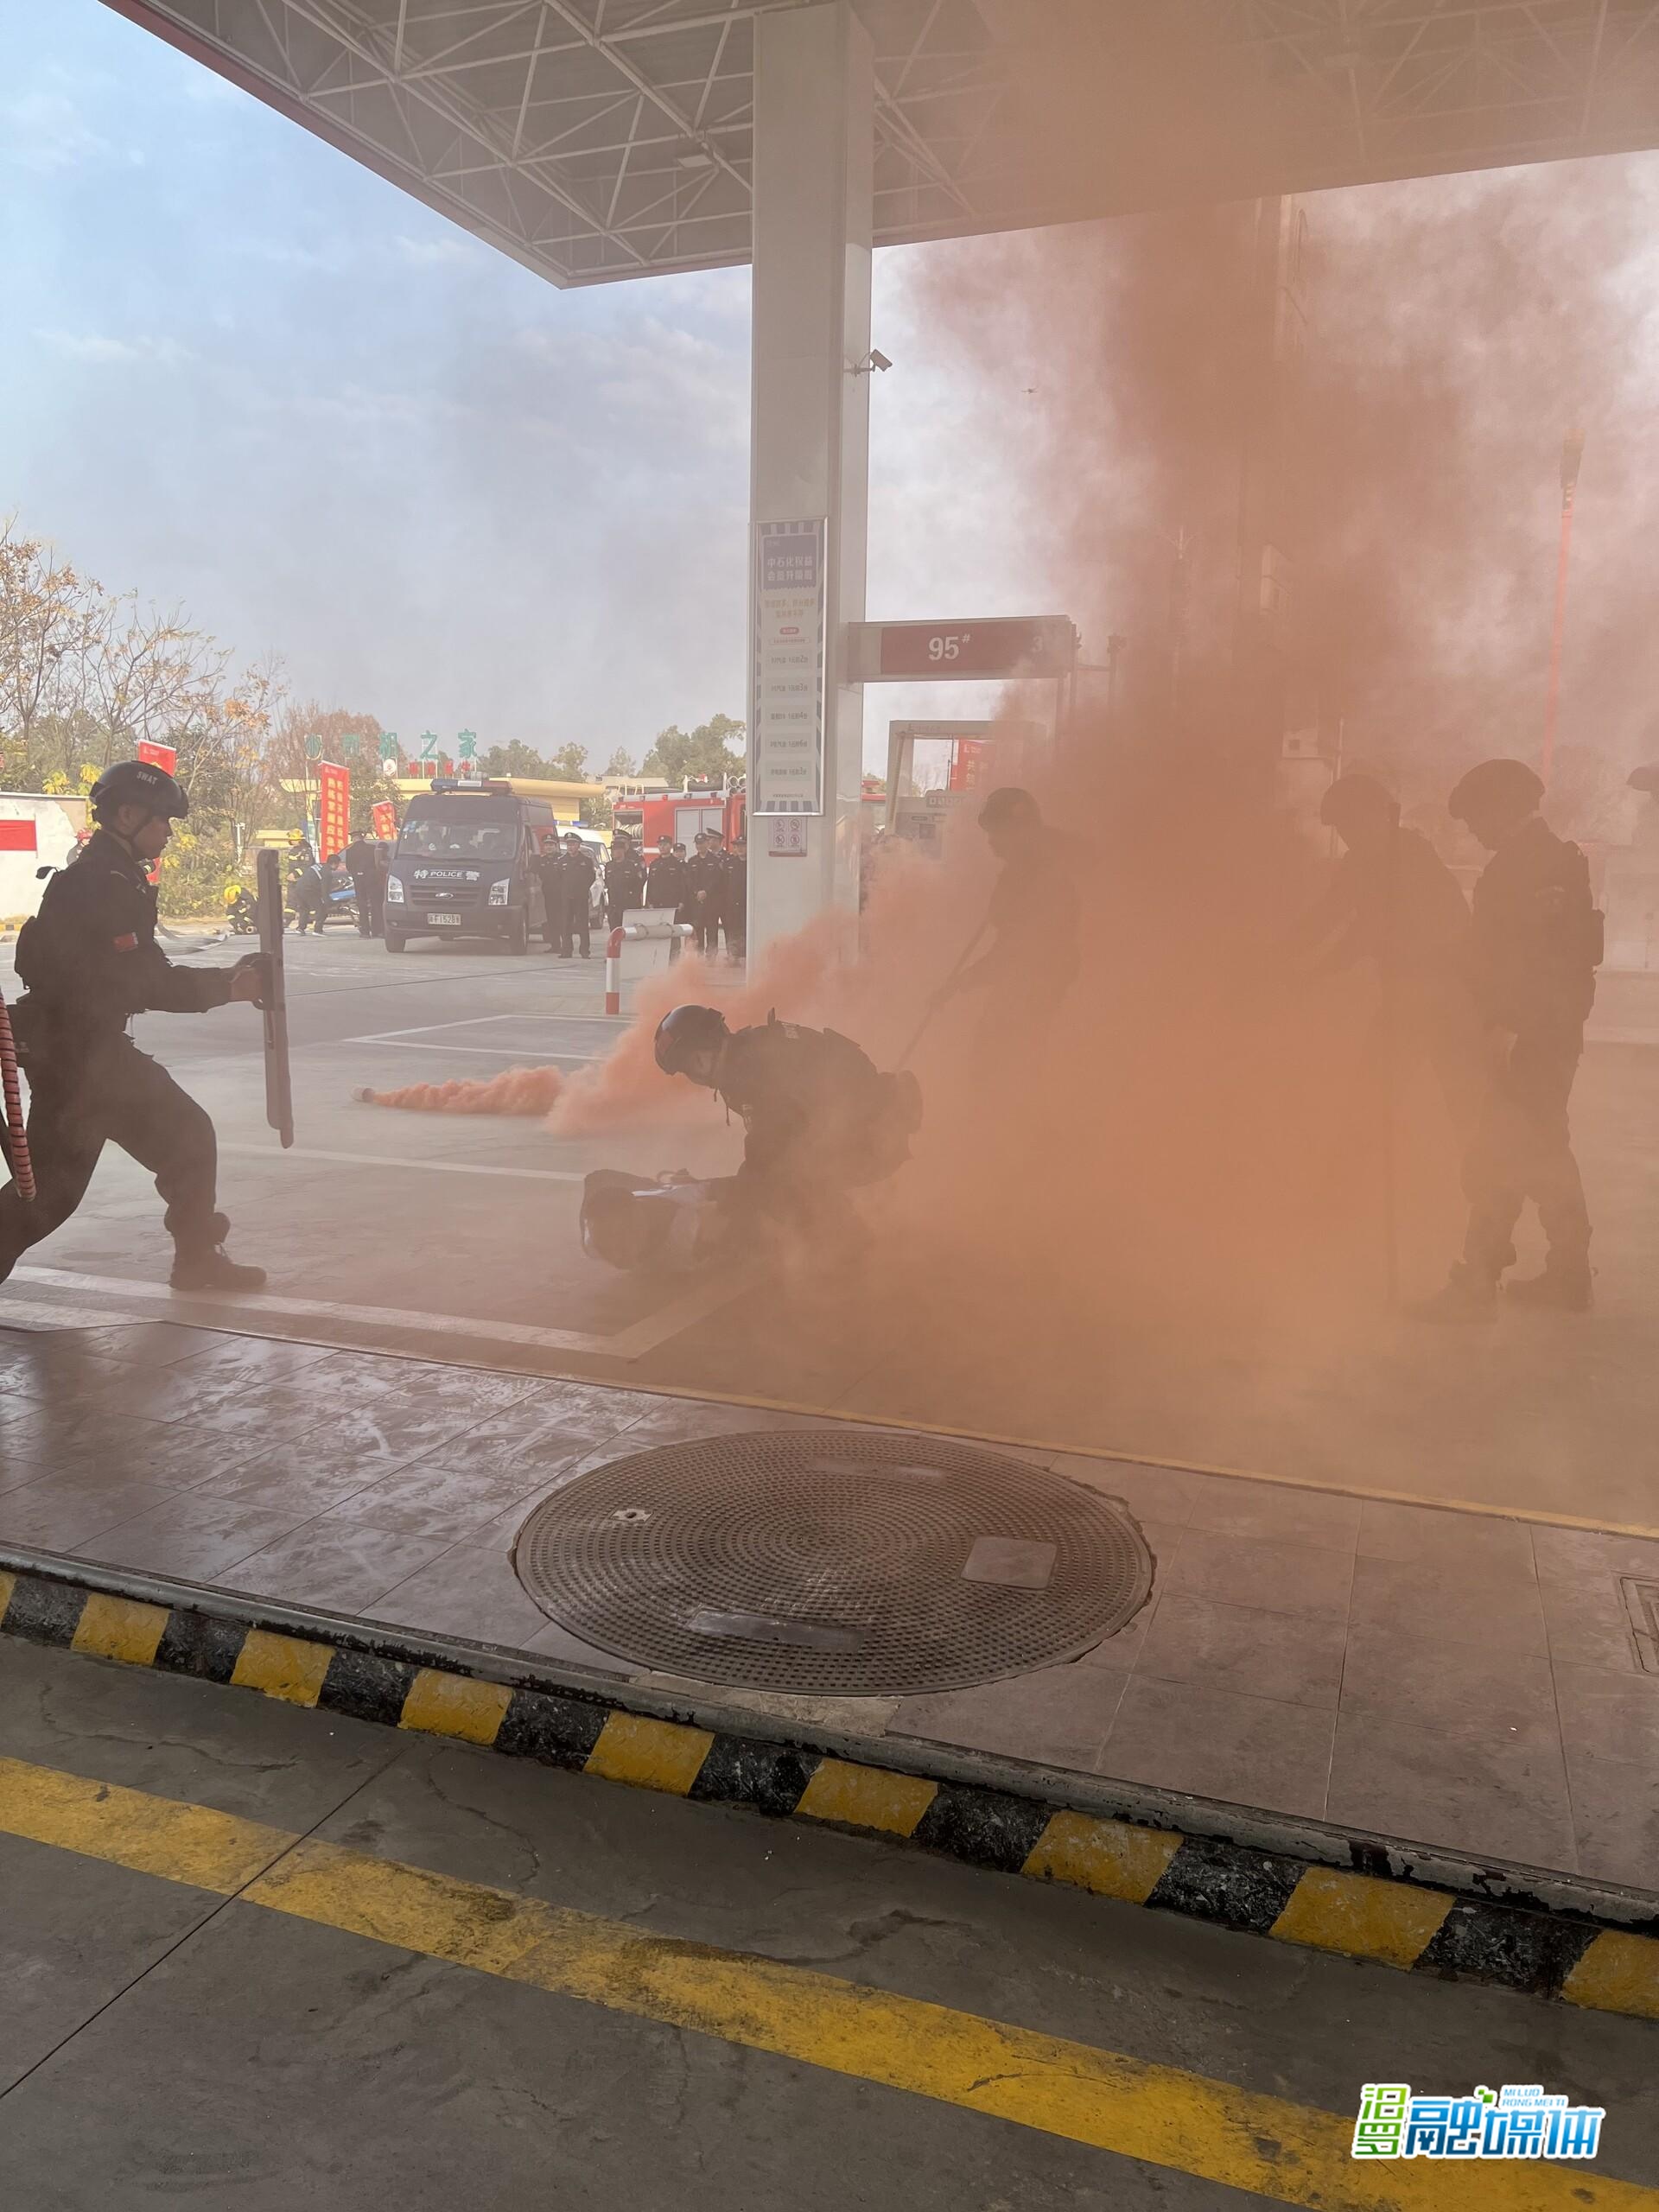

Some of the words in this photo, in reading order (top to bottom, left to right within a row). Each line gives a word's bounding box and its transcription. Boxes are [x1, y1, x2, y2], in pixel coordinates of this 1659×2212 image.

[928, 632, 970, 661] 95#
[136, 771, 158, 785] SWAT
[414, 869, 429, 880] 特
